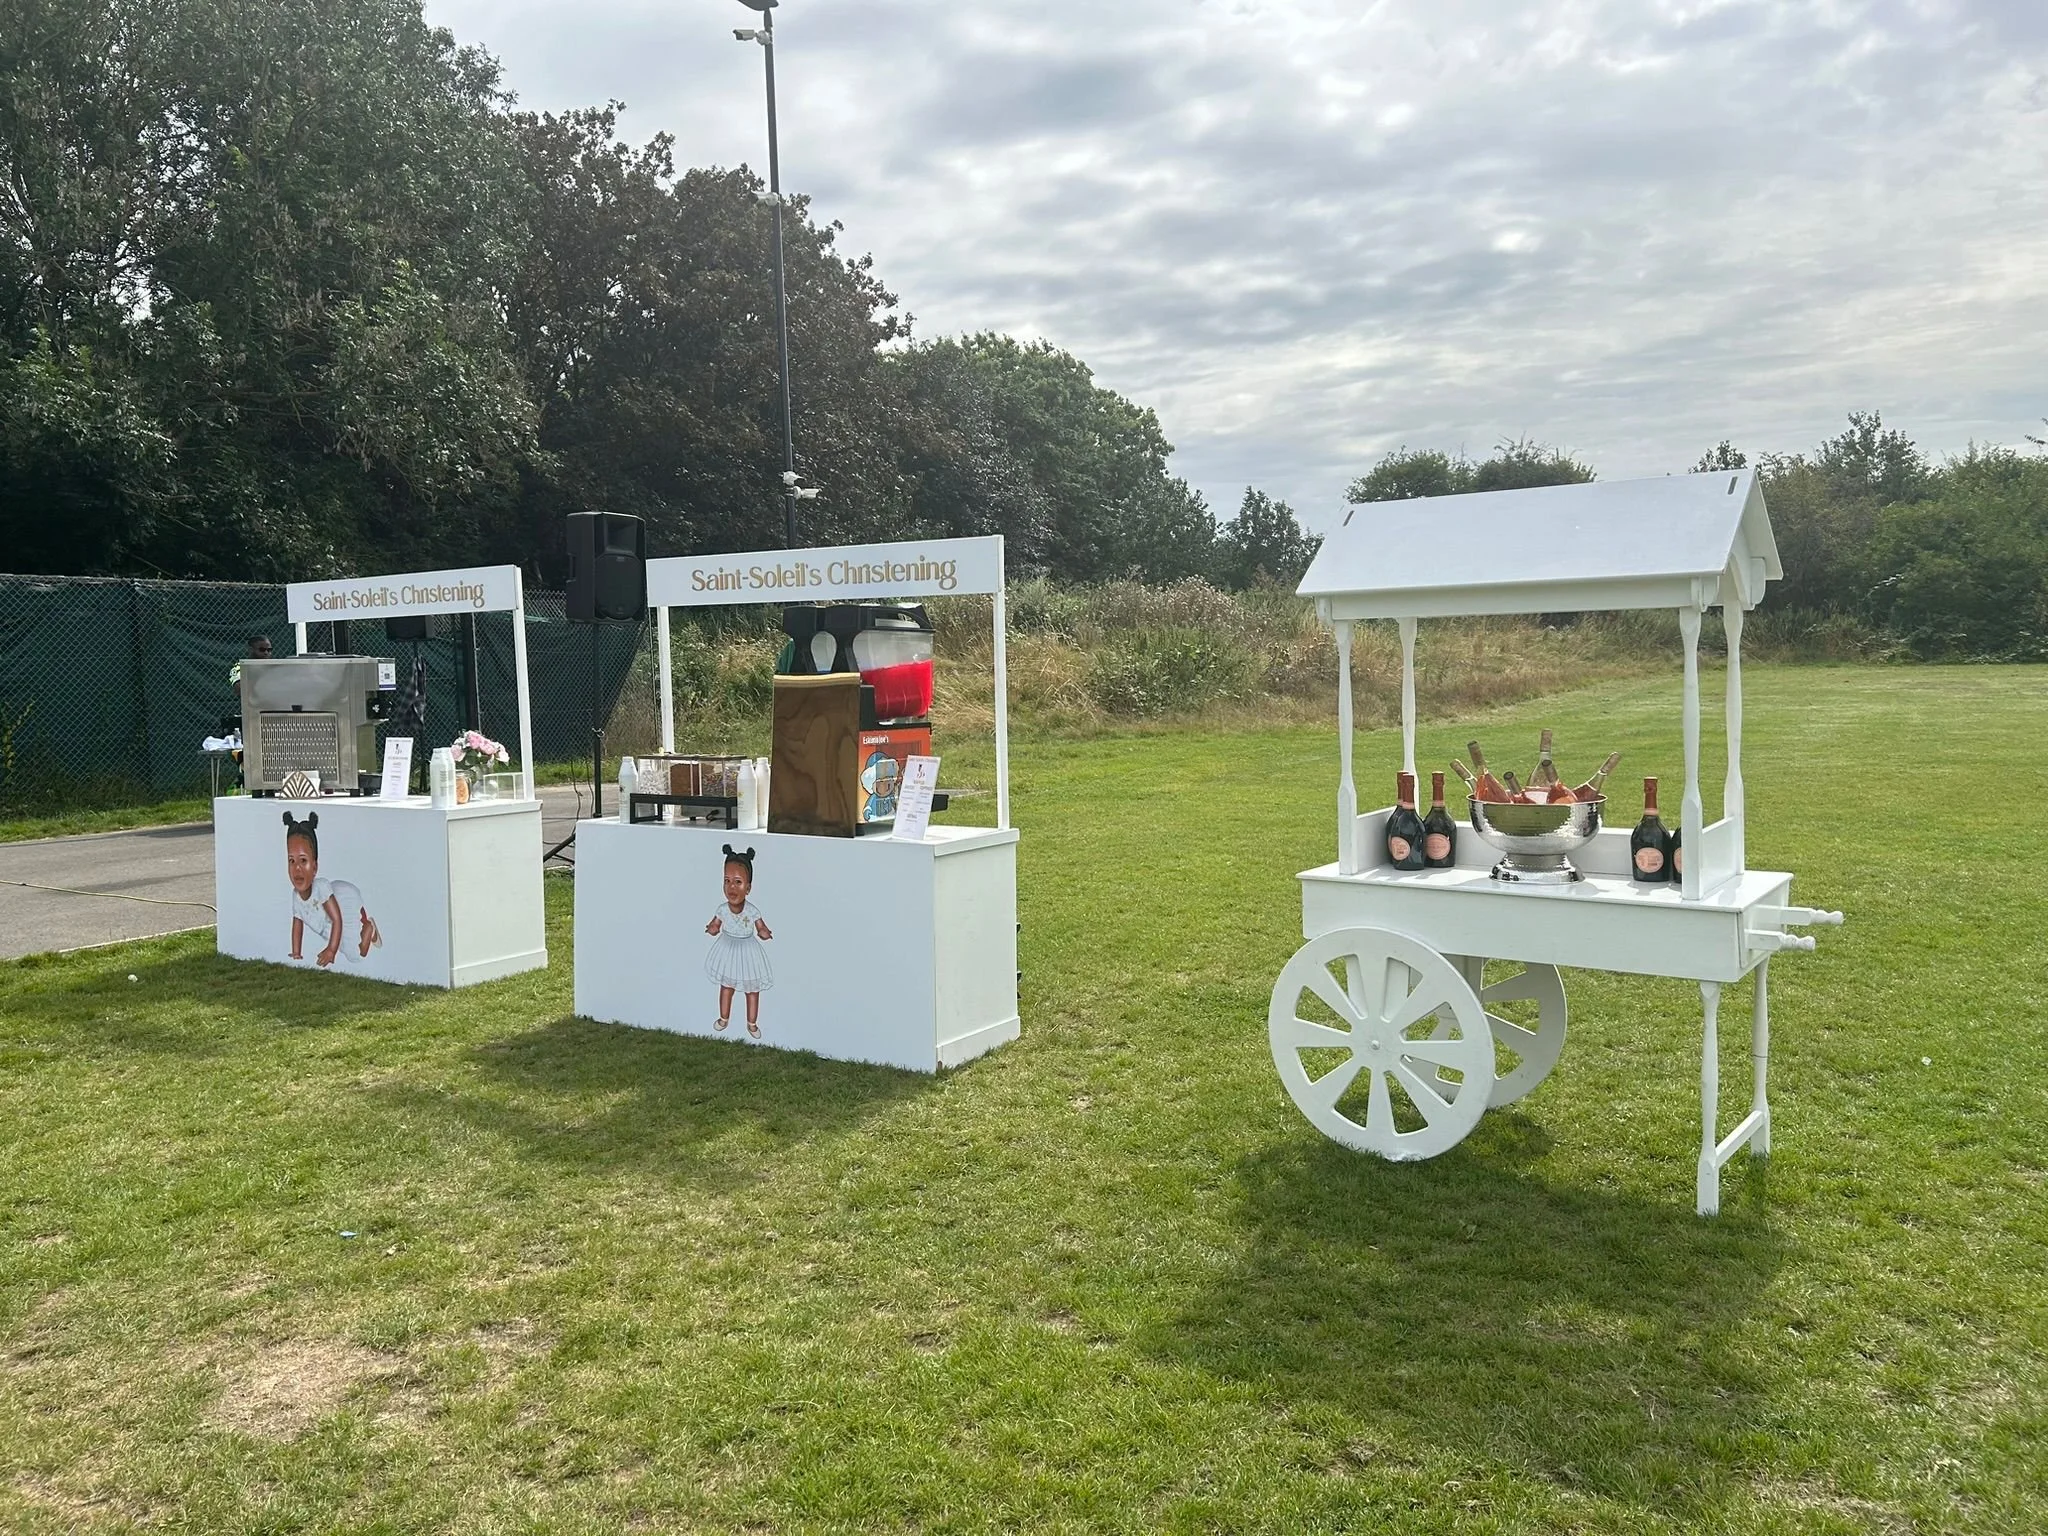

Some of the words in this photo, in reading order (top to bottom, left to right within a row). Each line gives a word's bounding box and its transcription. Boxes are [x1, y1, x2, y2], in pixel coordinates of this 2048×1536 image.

[691, 562, 821, 592] Saint-Soleil's
[827, 555, 958, 590] Christening
[313, 587, 398, 611] Saint-Soleil's
